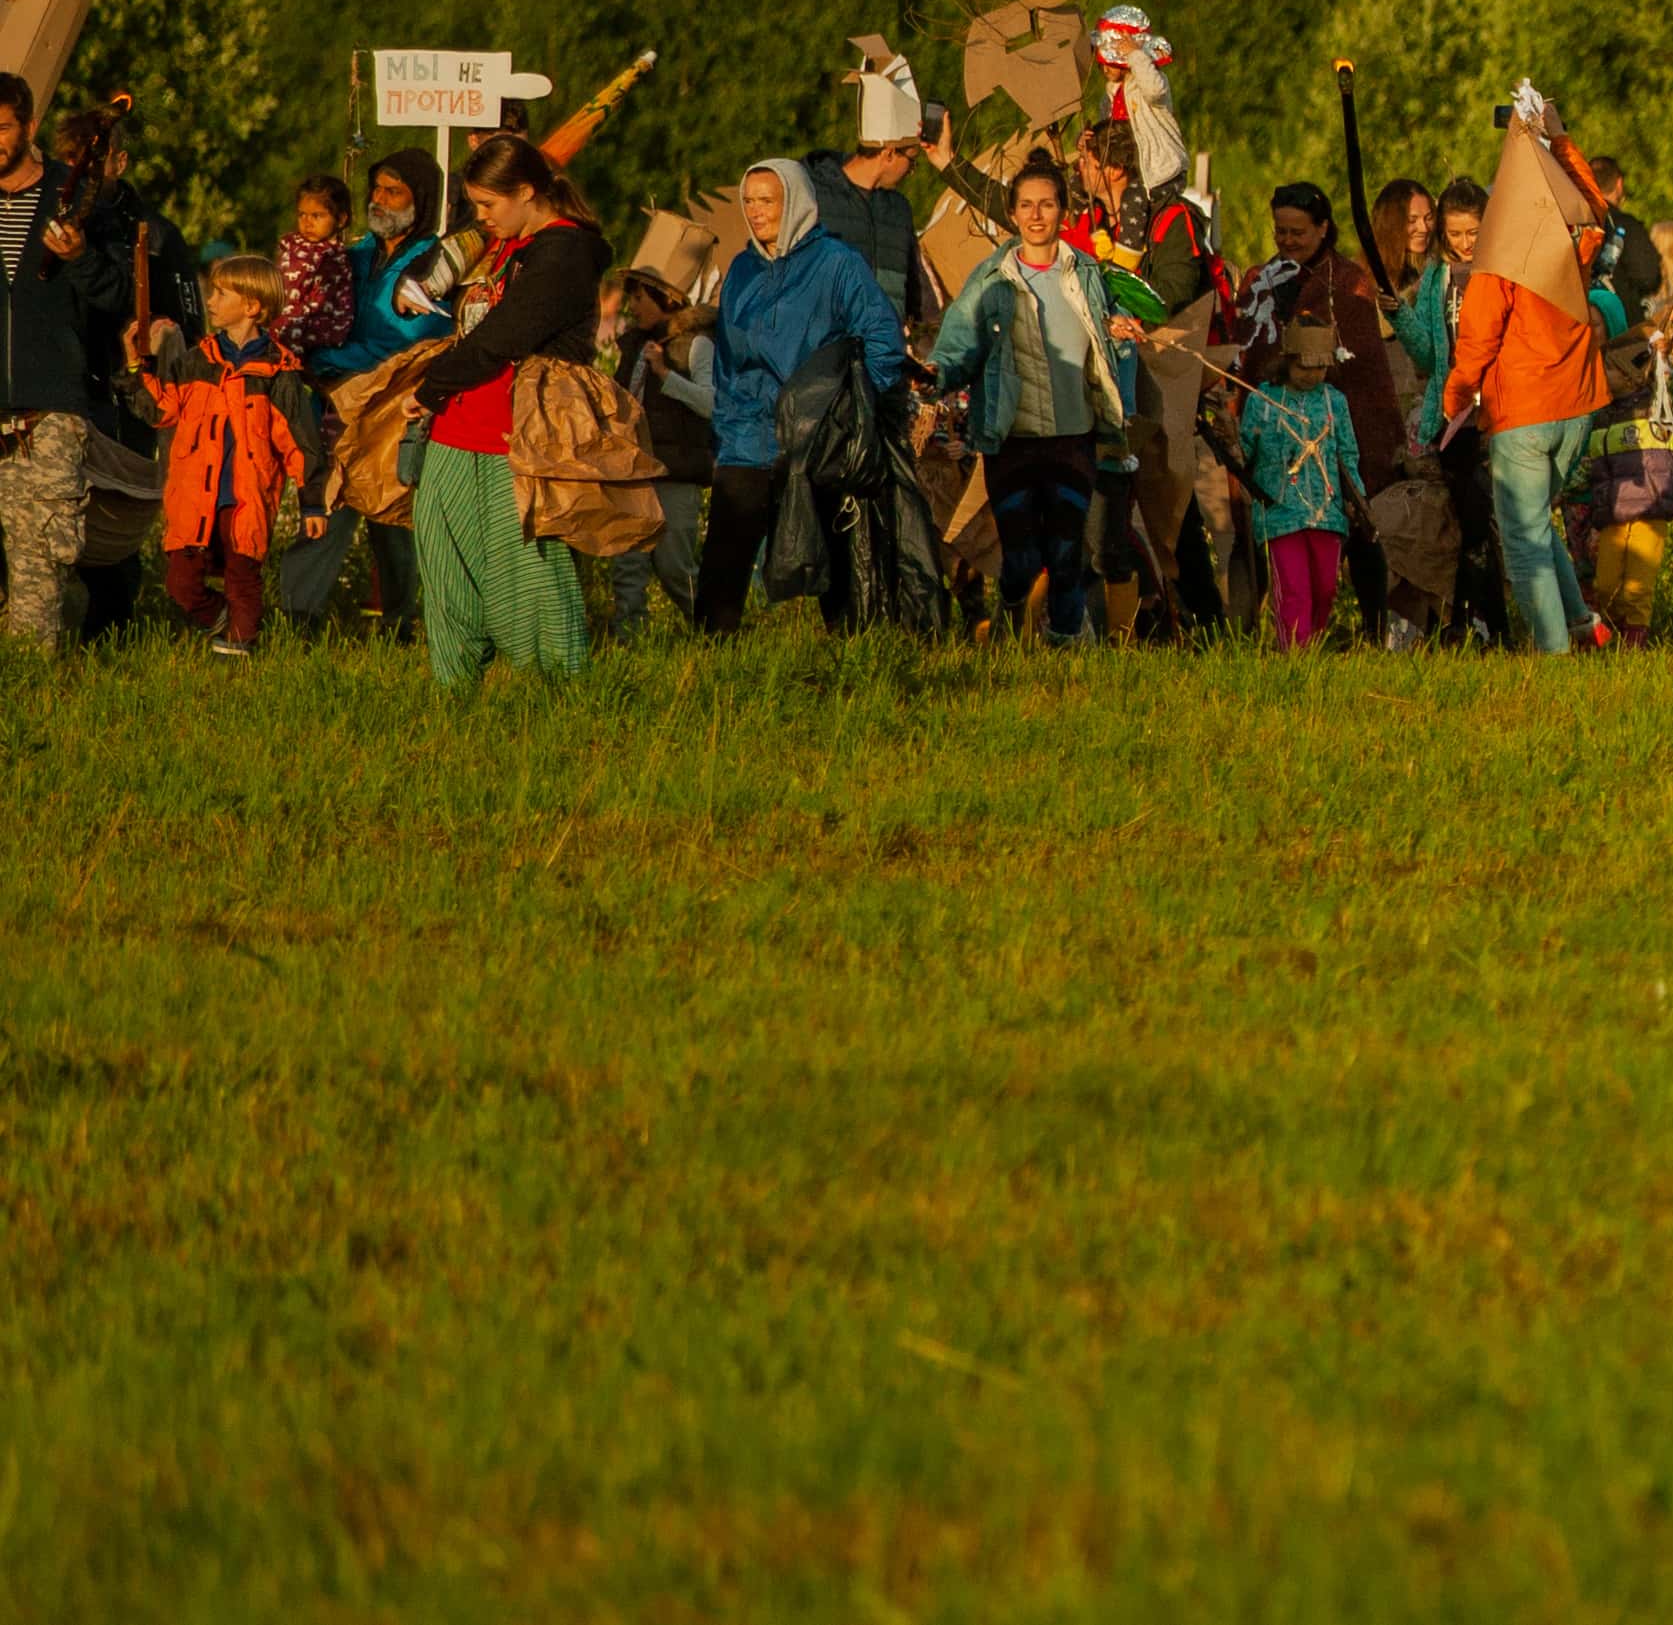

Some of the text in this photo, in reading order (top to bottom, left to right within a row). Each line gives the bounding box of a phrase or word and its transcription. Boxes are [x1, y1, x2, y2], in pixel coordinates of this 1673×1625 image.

[386, 54, 483, 83] МЫ НЕ
[386, 89, 485, 116] ПРОТИВ
